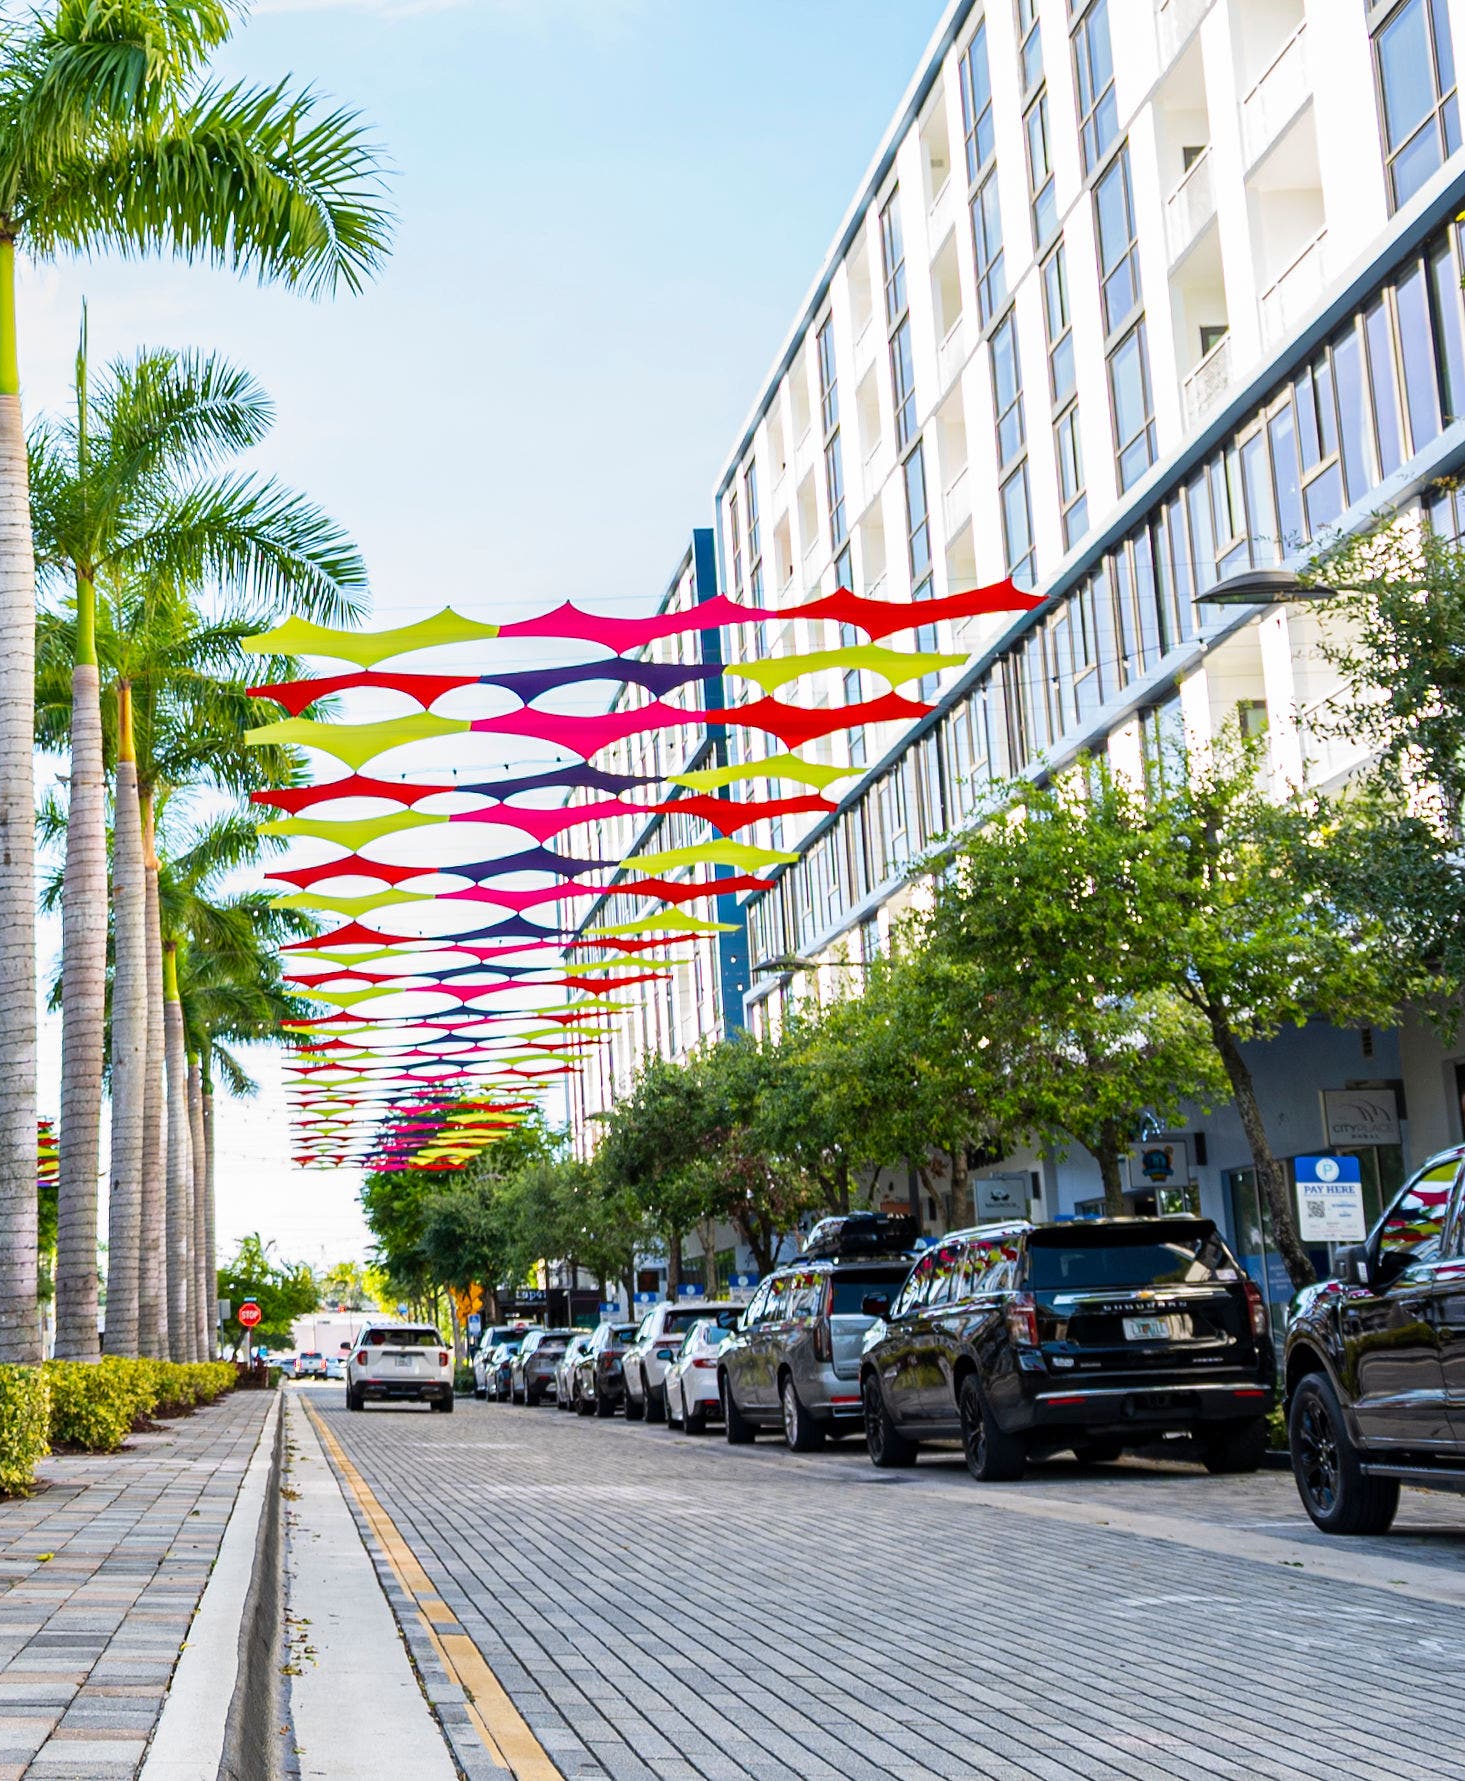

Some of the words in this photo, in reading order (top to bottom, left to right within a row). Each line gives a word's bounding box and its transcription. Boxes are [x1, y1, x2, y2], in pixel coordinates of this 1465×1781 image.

[1304, 1186, 1323, 1194] PAY
[1327, 1185, 1356, 1194] HERE
[242, 1310, 259, 1319] STOP
